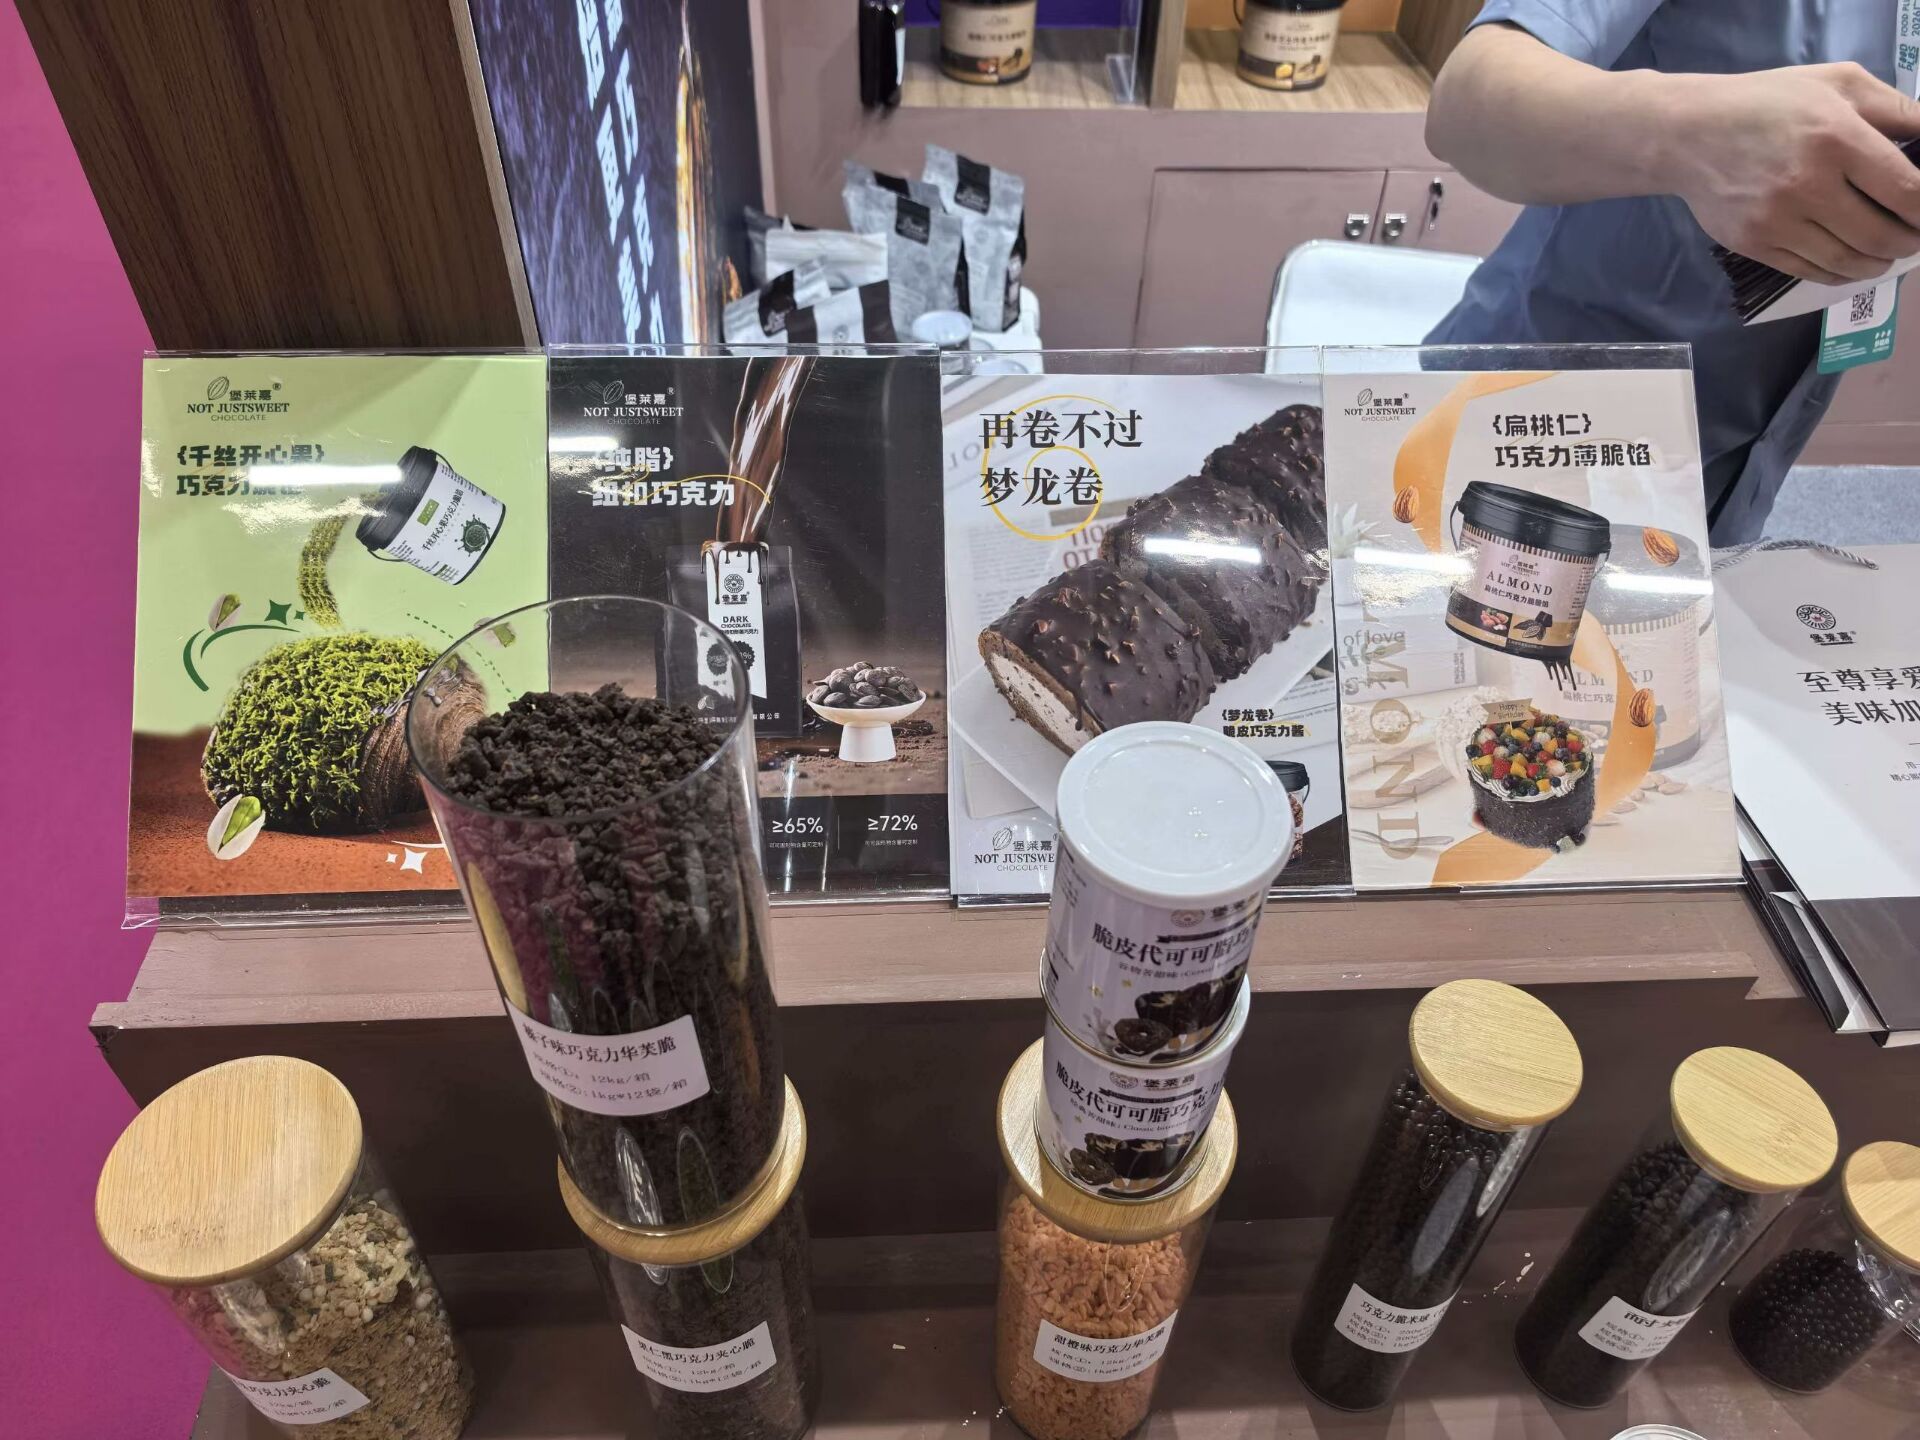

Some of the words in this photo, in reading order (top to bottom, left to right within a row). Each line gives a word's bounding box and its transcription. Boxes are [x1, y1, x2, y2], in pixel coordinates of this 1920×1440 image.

[187, 403, 213, 413] NOT
[217, 403, 289, 413] JUSTSWEET
[584, 408, 610, 417] NOT
[613, 407, 684, 417] JUSTSWEET
[1365, 407, 1416, 415] JUSTSWEET
[979, 409, 1143, 449] 再卷不过
[1492, 413, 1592, 436] {扁桃仁}
[1495, 445, 1651, 468] 巧克力薄脆馅
[592, 480, 735, 507] 纽扣巧克力
[979, 466, 1104, 507] 梦龙卷
[1486, 571, 1553, 596] ALMOND
[1222, 708, 1274, 722] {梦龙卷}
[1223, 724, 1305, 737] 脆皮巧克力酱
[974, 854, 999, 863] NOT
[1002, 853, 1055, 863] JUSTSWE
